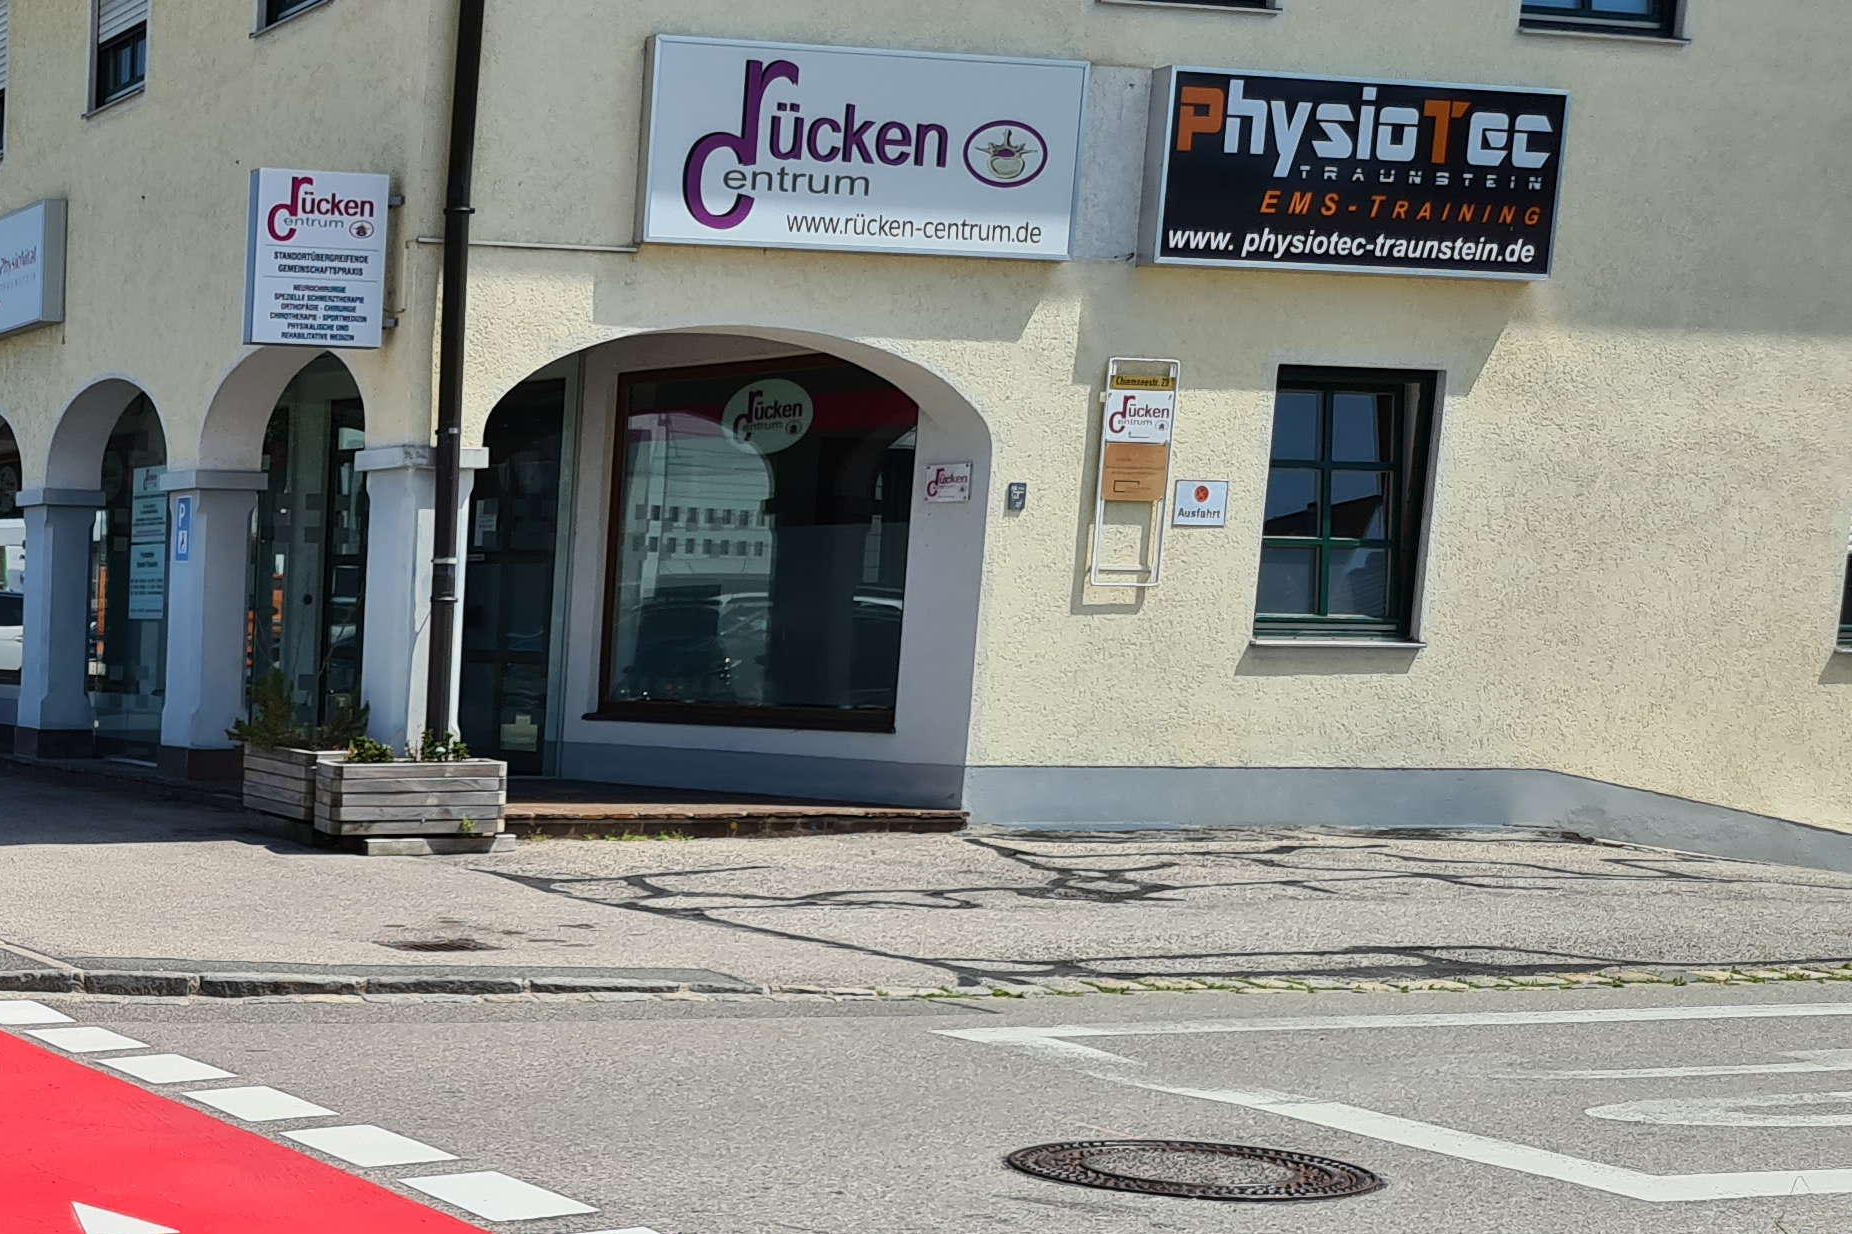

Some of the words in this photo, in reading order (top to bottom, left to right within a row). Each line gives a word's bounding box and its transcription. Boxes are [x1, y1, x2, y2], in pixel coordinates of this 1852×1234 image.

[741, 59, 948, 168] rücken
[290, 176, 374, 218] rücken
[786, 212, 1043, 244] www.rücken-centrum.de
[273, 251, 369, 264] STANDORTÜBERGREIFENDE
[1168, 228, 1235, 252] www.
[1241, 228, 1536, 264] physiotec-traunstein.de
[277, 264, 364, 276] GEMEINSCHAFTSPRAXIS
[748, 389, 803, 424] rücken
[1122, 394, 1170, 419] rücken
[177, 502, 187, 528] P
[1176, 506, 1221, 519] Ausfahrt
